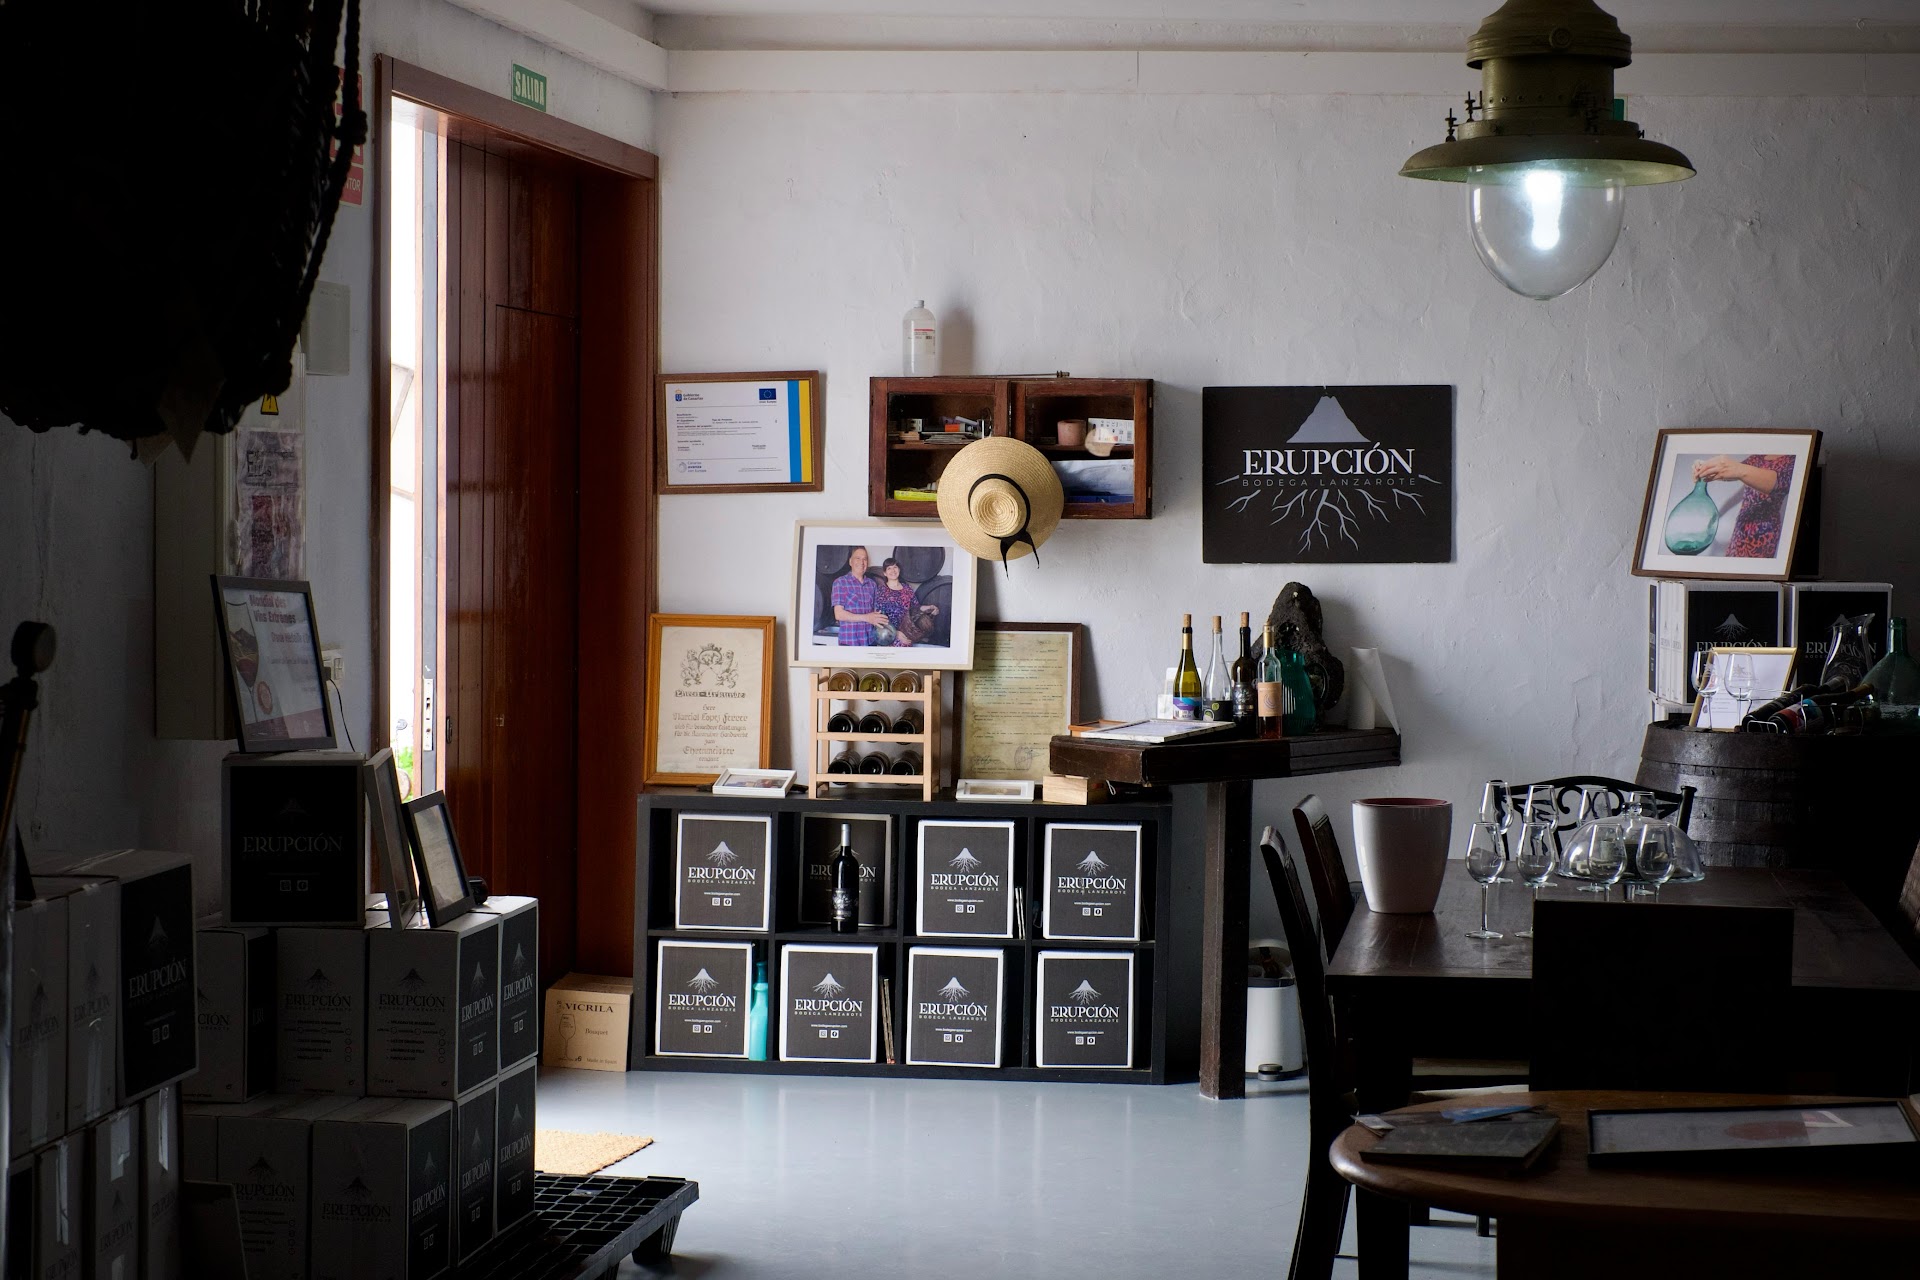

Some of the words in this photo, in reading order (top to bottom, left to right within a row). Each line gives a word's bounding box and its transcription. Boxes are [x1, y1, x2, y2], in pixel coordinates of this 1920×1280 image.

[515, 71, 544, 106] SALIDA
[1243, 442, 1415, 476] ERUPCIÓN
[1243, 479, 1308, 487] BODEGA
[1320, 478, 1416, 487] LANZAROTE
[253, 610, 267, 622] Vins
[242, 832, 343, 852] ERUPCIÓN
[688, 866, 756, 880] ERUPCIÓN
[810, 864, 877, 878] ERUÓN
[930, 872, 999, 886] ERUPCIÓN
[1058, 875, 1127, 890] ERUPCIÓN
[129, 957, 187, 998] ERUPCIÓN
[503, 973, 533, 1000] ERUPCIÓN
[286, 993, 351, 1007] ERUPCIÓN
[379, 993, 446, 1008] ERUPCIÓN
[668, 992, 736, 1007] ERUPCIÓN
[794, 997, 863, 1012] ERUPCIÓN
[461, 993, 494, 1022] ERUPCIÓN
[565, 1003, 613, 1013] VICRILA
[919, 1002, 988, 1017] ERUPCIÓN
[1051, 1004, 1119, 1018] ERUPCIÓN
[198, 1012, 230, 1025] CIÓN
[500, 1132, 531, 1163] ERUPCIÓN
[462, 1158, 491, 1190] ERUPCIÓN
[235, 1182, 295, 1197] RUPCIÓN
[412, 1182, 446, 1217] ERUPCIÓN
[323, 1203, 391, 1217] ERUPCIÓN
